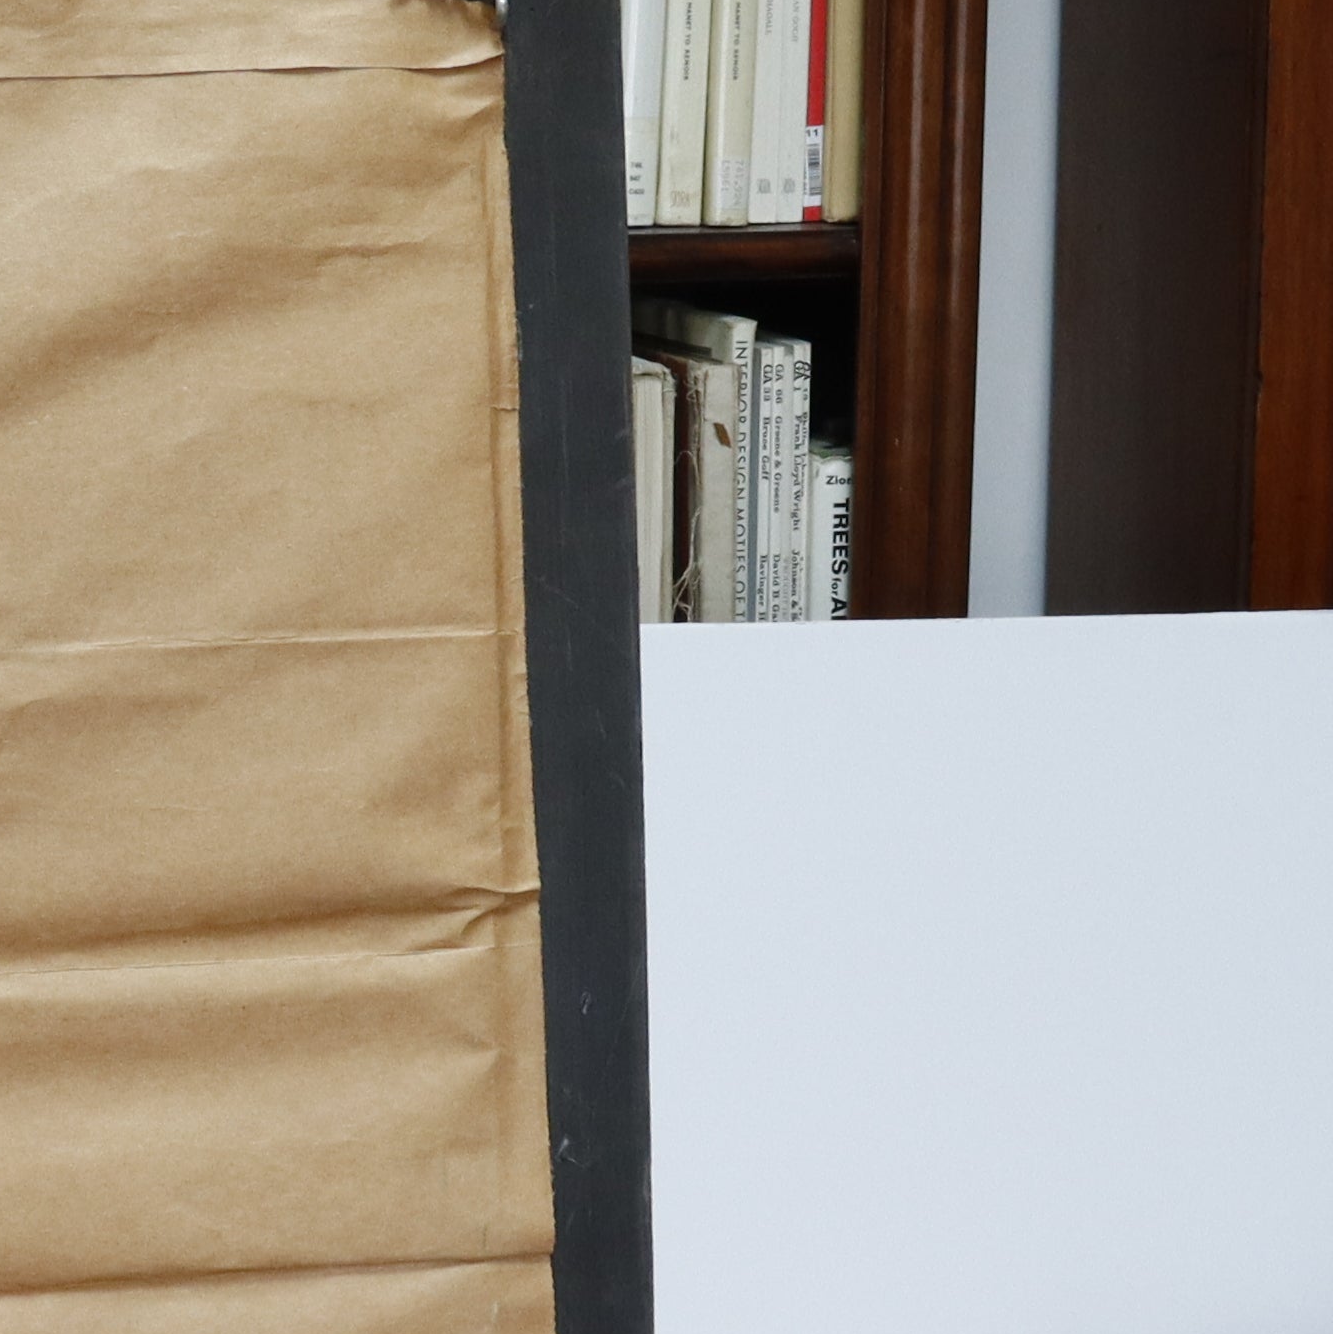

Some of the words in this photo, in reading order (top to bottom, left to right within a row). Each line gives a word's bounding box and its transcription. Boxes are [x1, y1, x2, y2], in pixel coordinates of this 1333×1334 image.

[685, 2, 693, 30] MANET
[734, 2, 742, 30] MANET
[685, 33, 691, 46] TO
[734, 33, 741, 46] TO
[732, 48, 740, 81] RENOIR
[762, 364, 773, 384] GA
[774, 363, 784, 382] GA
[793, 360, 804, 380] GA
[761, 416, 771, 451] Bruce
[774, 415, 783, 457] Greene
[793, 414, 804, 450] Frank
[736, 431, 748, 501] DESIGN
[761, 454, 771, 481] Goff
[791, 453, 804, 487] Lloyd
[774, 471, 783, 513] Greene
[791, 489, 804, 532] Wright
[735, 508, 748, 573] MOTIFS
[831, 497, 850, 575] TREES
[756, 554, 767, 607] Bavinger
[773, 554, 782, 587] David
[792, 548, 801, 597] Johnson
[831, 577, 842, 597] for
[735, 580, 746, 605] OF
